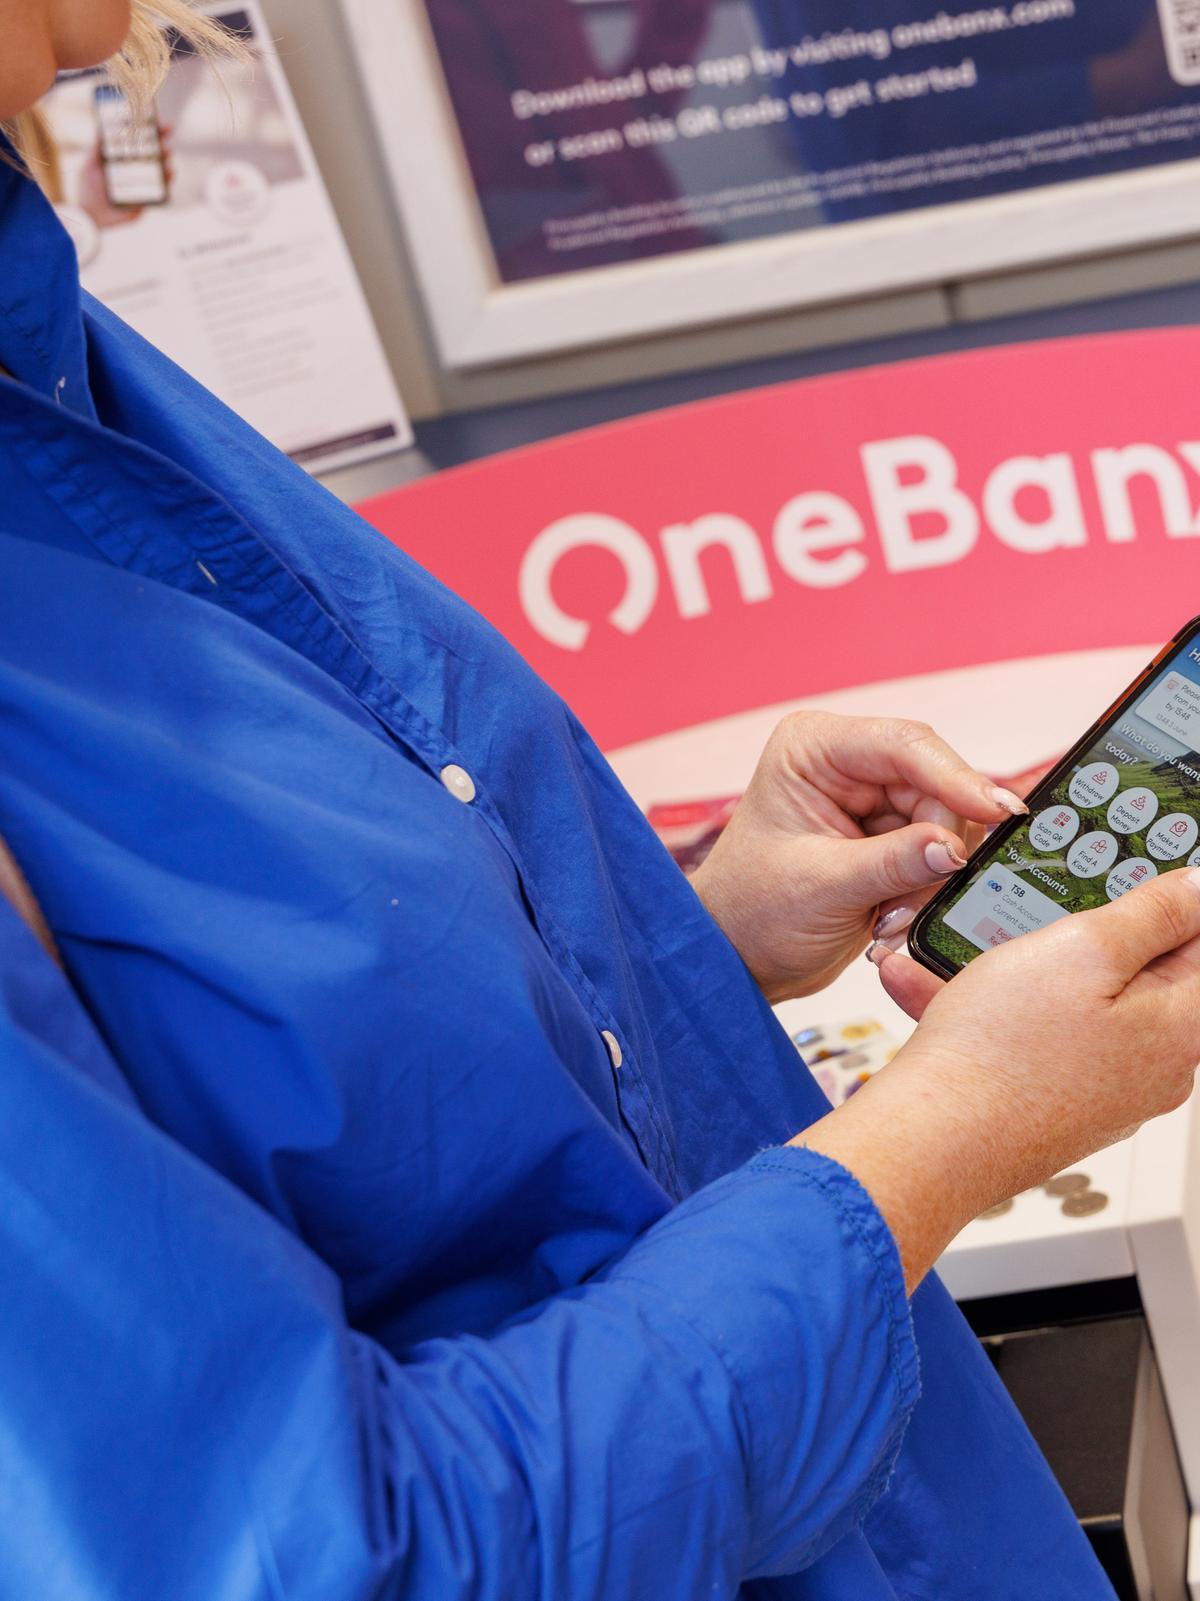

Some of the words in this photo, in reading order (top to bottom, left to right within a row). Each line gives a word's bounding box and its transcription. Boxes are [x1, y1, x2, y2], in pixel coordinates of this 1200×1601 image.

[511, 69, 646, 119] Download
[648, 62, 696, 94] the
[697, 54, 751, 88] app
[751, 46, 788, 77] by
[790, 27, 892, 66] visiting
[891, 0, 1075, 49] onebanx.com
[523, 139, 556, 168] or
[558, 128, 623, 162] scan
[624, 112, 677, 148] this
[677, 103, 722, 139] QR
[722, 95, 788, 131] code
[790, 90, 824, 119] to
[825, 79, 872, 118] get
[875, 56, 978, 103] started
[1173, 693, 1188, 708] from
[1182, 684, 1200, 701] Please
[1165, 702, 1173, 711] by
[1105, 741, 1139, 767] today?
[1119, 723, 1147, 748] What
[1146, 738, 1161, 755] do
[1157, 749, 1177, 766] you
[1072, 789, 1093, 808] Money
[1075, 777, 1105, 801] Withdraw
[1110, 814, 1132, 834] Money
[1115, 805, 1140, 826] Deposit
[1034, 833, 1050, 848] Code
[1036, 822, 1051, 837] Scan
[1052, 832, 1063, 844] QR
[1156, 832, 1174, 849] Make
[1173, 843, 1180, 851] A
[1077, 850, 1091, 863] Find
[1090, 857, 1098, 867] A
[1146, 838, 1175, 861] Payment
[1006, 847, 1029, 869] Your
[1025, 862, 1070, 897] Accounts
[1072, 859, 1089, 875] Kiosk
[1112, 874, 1126, 886] Add
[1011, 884, 1026, 897] TSB
[993, 904, 1018, 925] Current
[1017, 905, 1042, 925] Account
